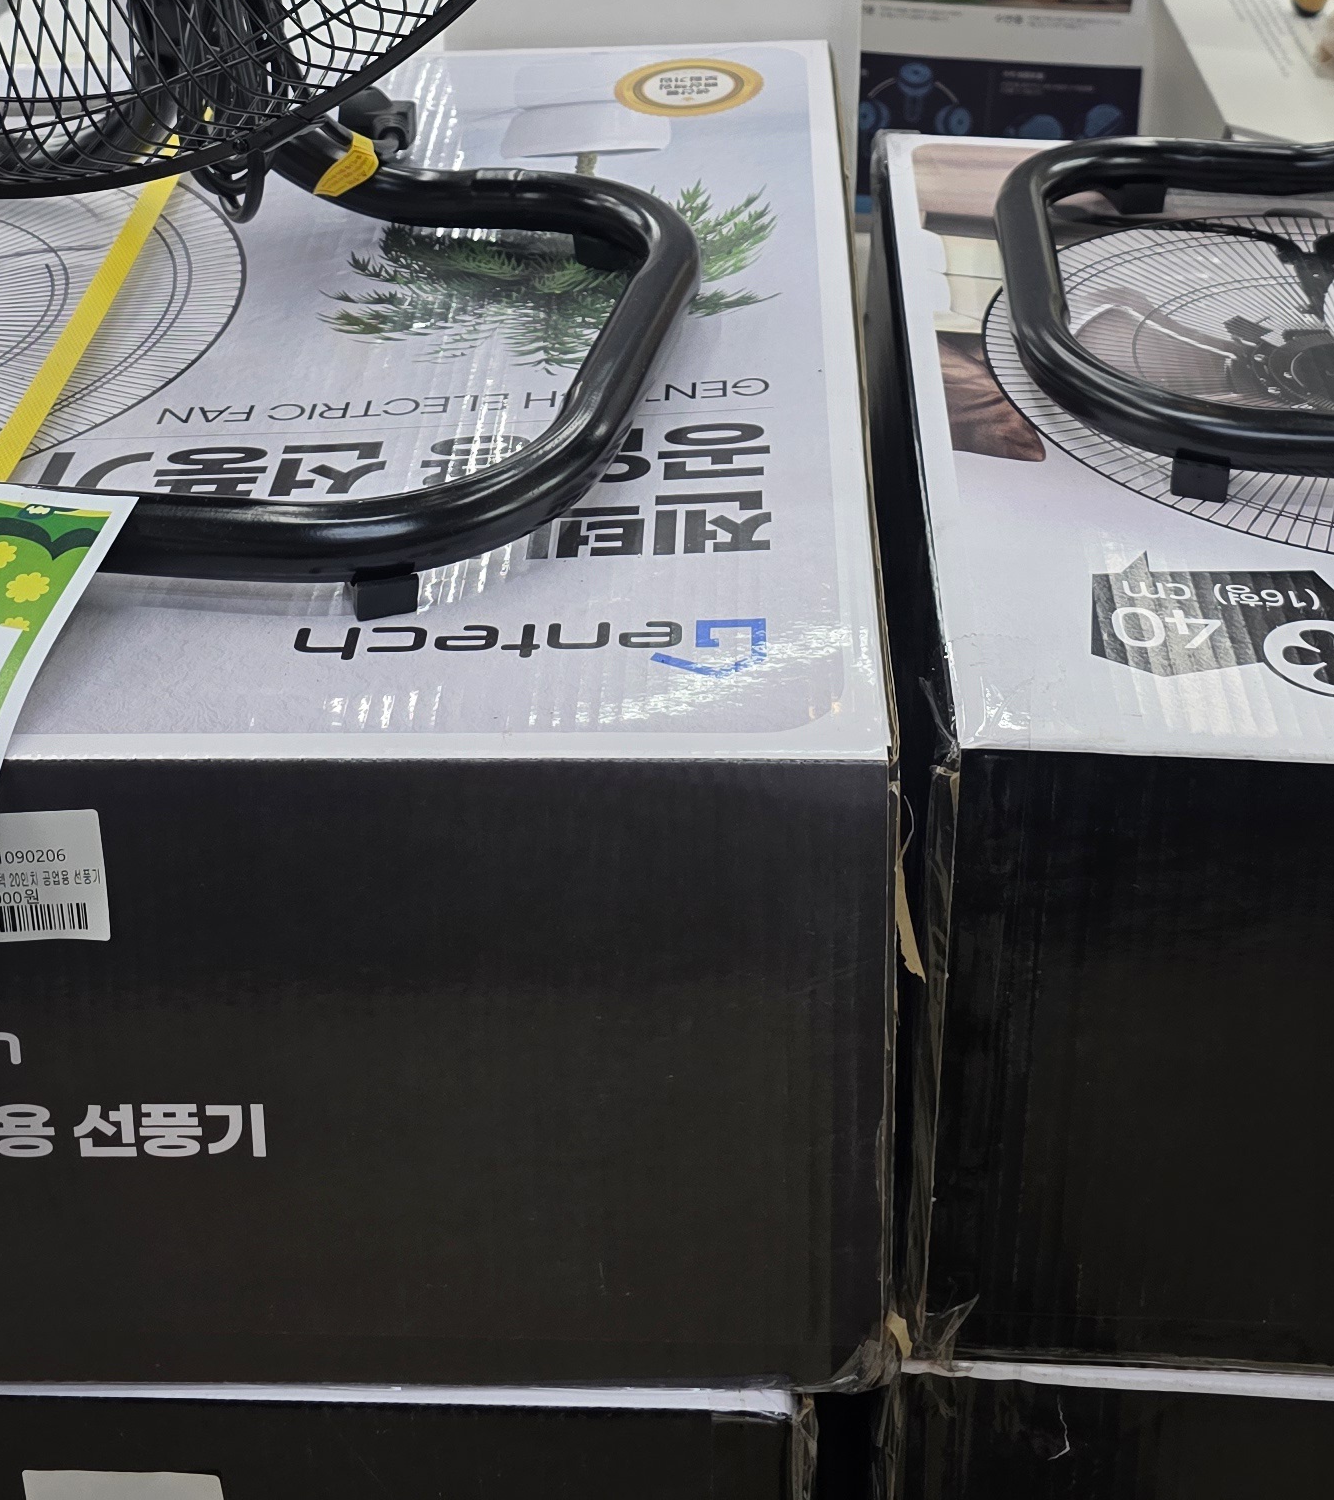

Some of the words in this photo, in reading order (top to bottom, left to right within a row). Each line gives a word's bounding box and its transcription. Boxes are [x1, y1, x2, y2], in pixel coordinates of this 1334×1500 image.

[156, 403, 256, 426] FAN
[268, 391, 510, 423] ELECTRIC
[1122, 580, 1193, 602] cm
[1213, 583, 1321, 610] (16형)
[1110, 607, 1222, 650] 40
[294, 617, 767, 679] Gentech
[9, 871, 38, 887] 20인치
[42, 870, 69, 886] 공업용
[74, 869, 100, 884] 선풍기
[73, 1103, 267, 1158] 선풍기
